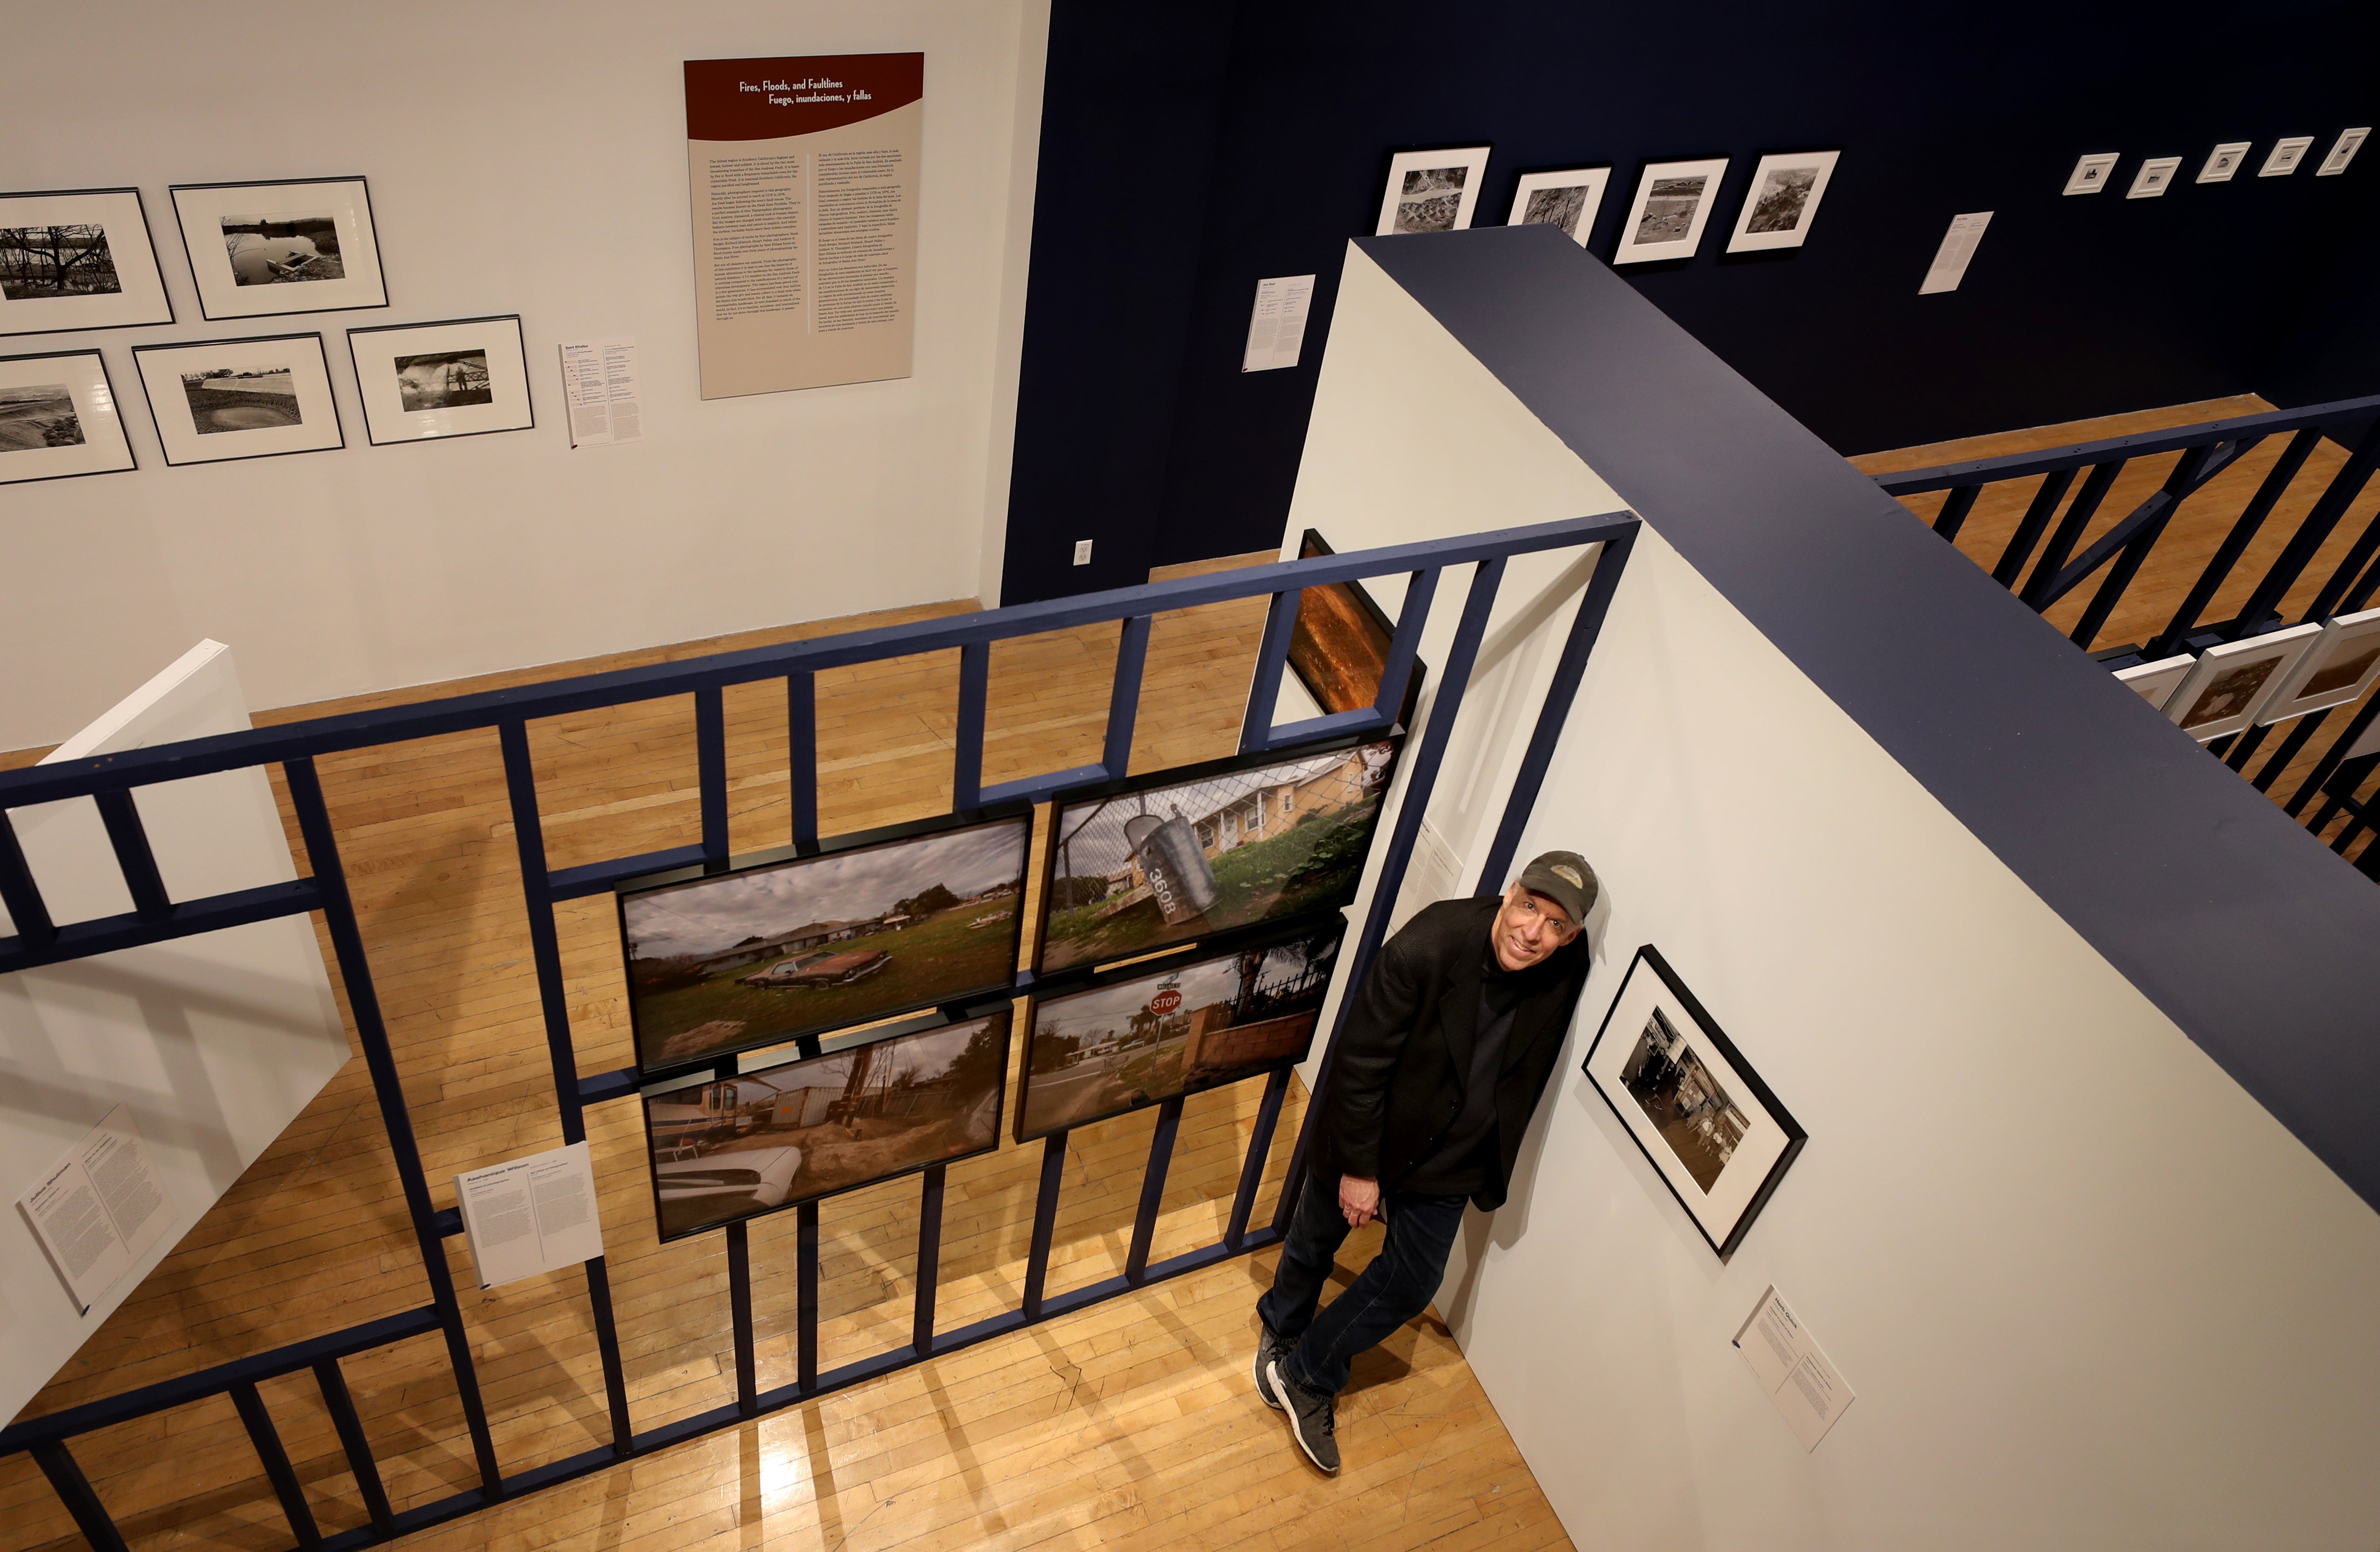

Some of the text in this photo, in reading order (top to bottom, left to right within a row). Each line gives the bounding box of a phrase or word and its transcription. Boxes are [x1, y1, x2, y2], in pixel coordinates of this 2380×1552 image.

[740, 78, 843, 92] Fires, Floods, and Faultlines
[769, 90, 872, 106] Fuego, inundaciones, y fallas
[1150, 868, 1176, 914] 3608
[1152, 996, 1180, 1009] STOP
[507, 1163, 529, 1172] Wilson
[30, 1186, 46, 1203] Julius
[1774, 1298, 1798, 1329] Herb Quick
